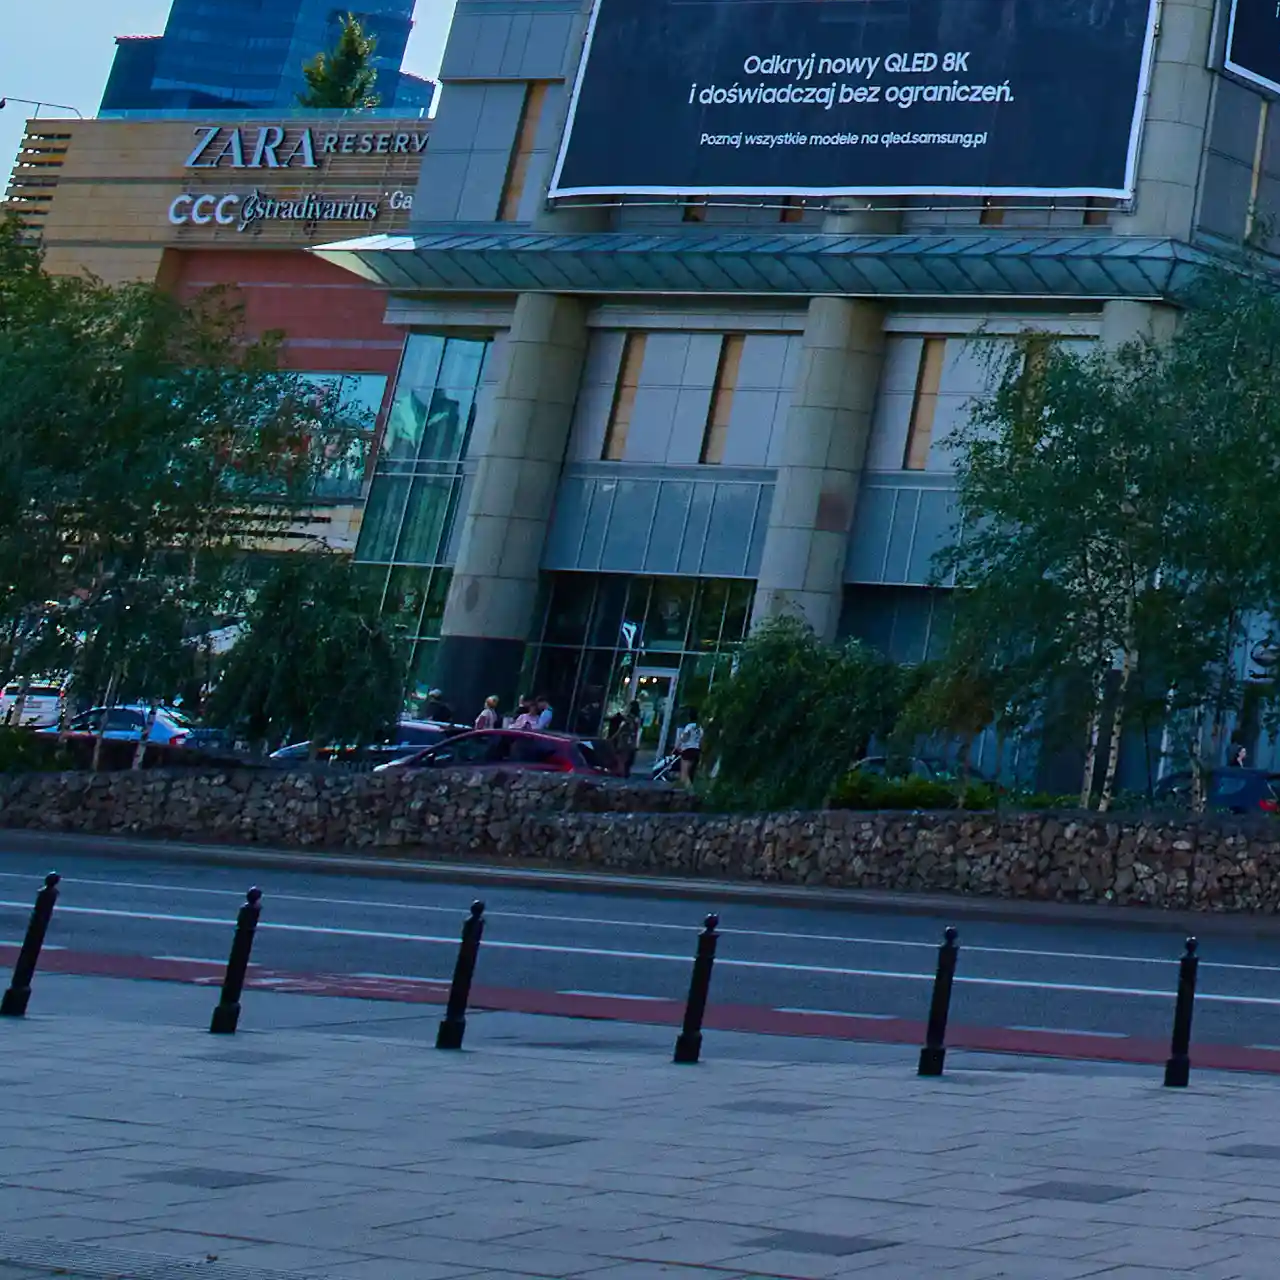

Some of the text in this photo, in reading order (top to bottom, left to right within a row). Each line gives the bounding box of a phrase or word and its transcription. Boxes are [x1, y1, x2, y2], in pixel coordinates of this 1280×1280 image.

[743, 52, 970, 80] Odkryj nowy QLED 8K
[688, 80, 1014, 109] i doświadczaj bez ograniczeń.
[183, 126, 429, 168] ZARA RESERV
[700, 132, 743, 149] Poznaj
[744, 133, 807, 149] wszystkie
[809, 132, 858, 146] modele
[861, 133, 879, 146] na
[168, 194, 239, 225] CCC
